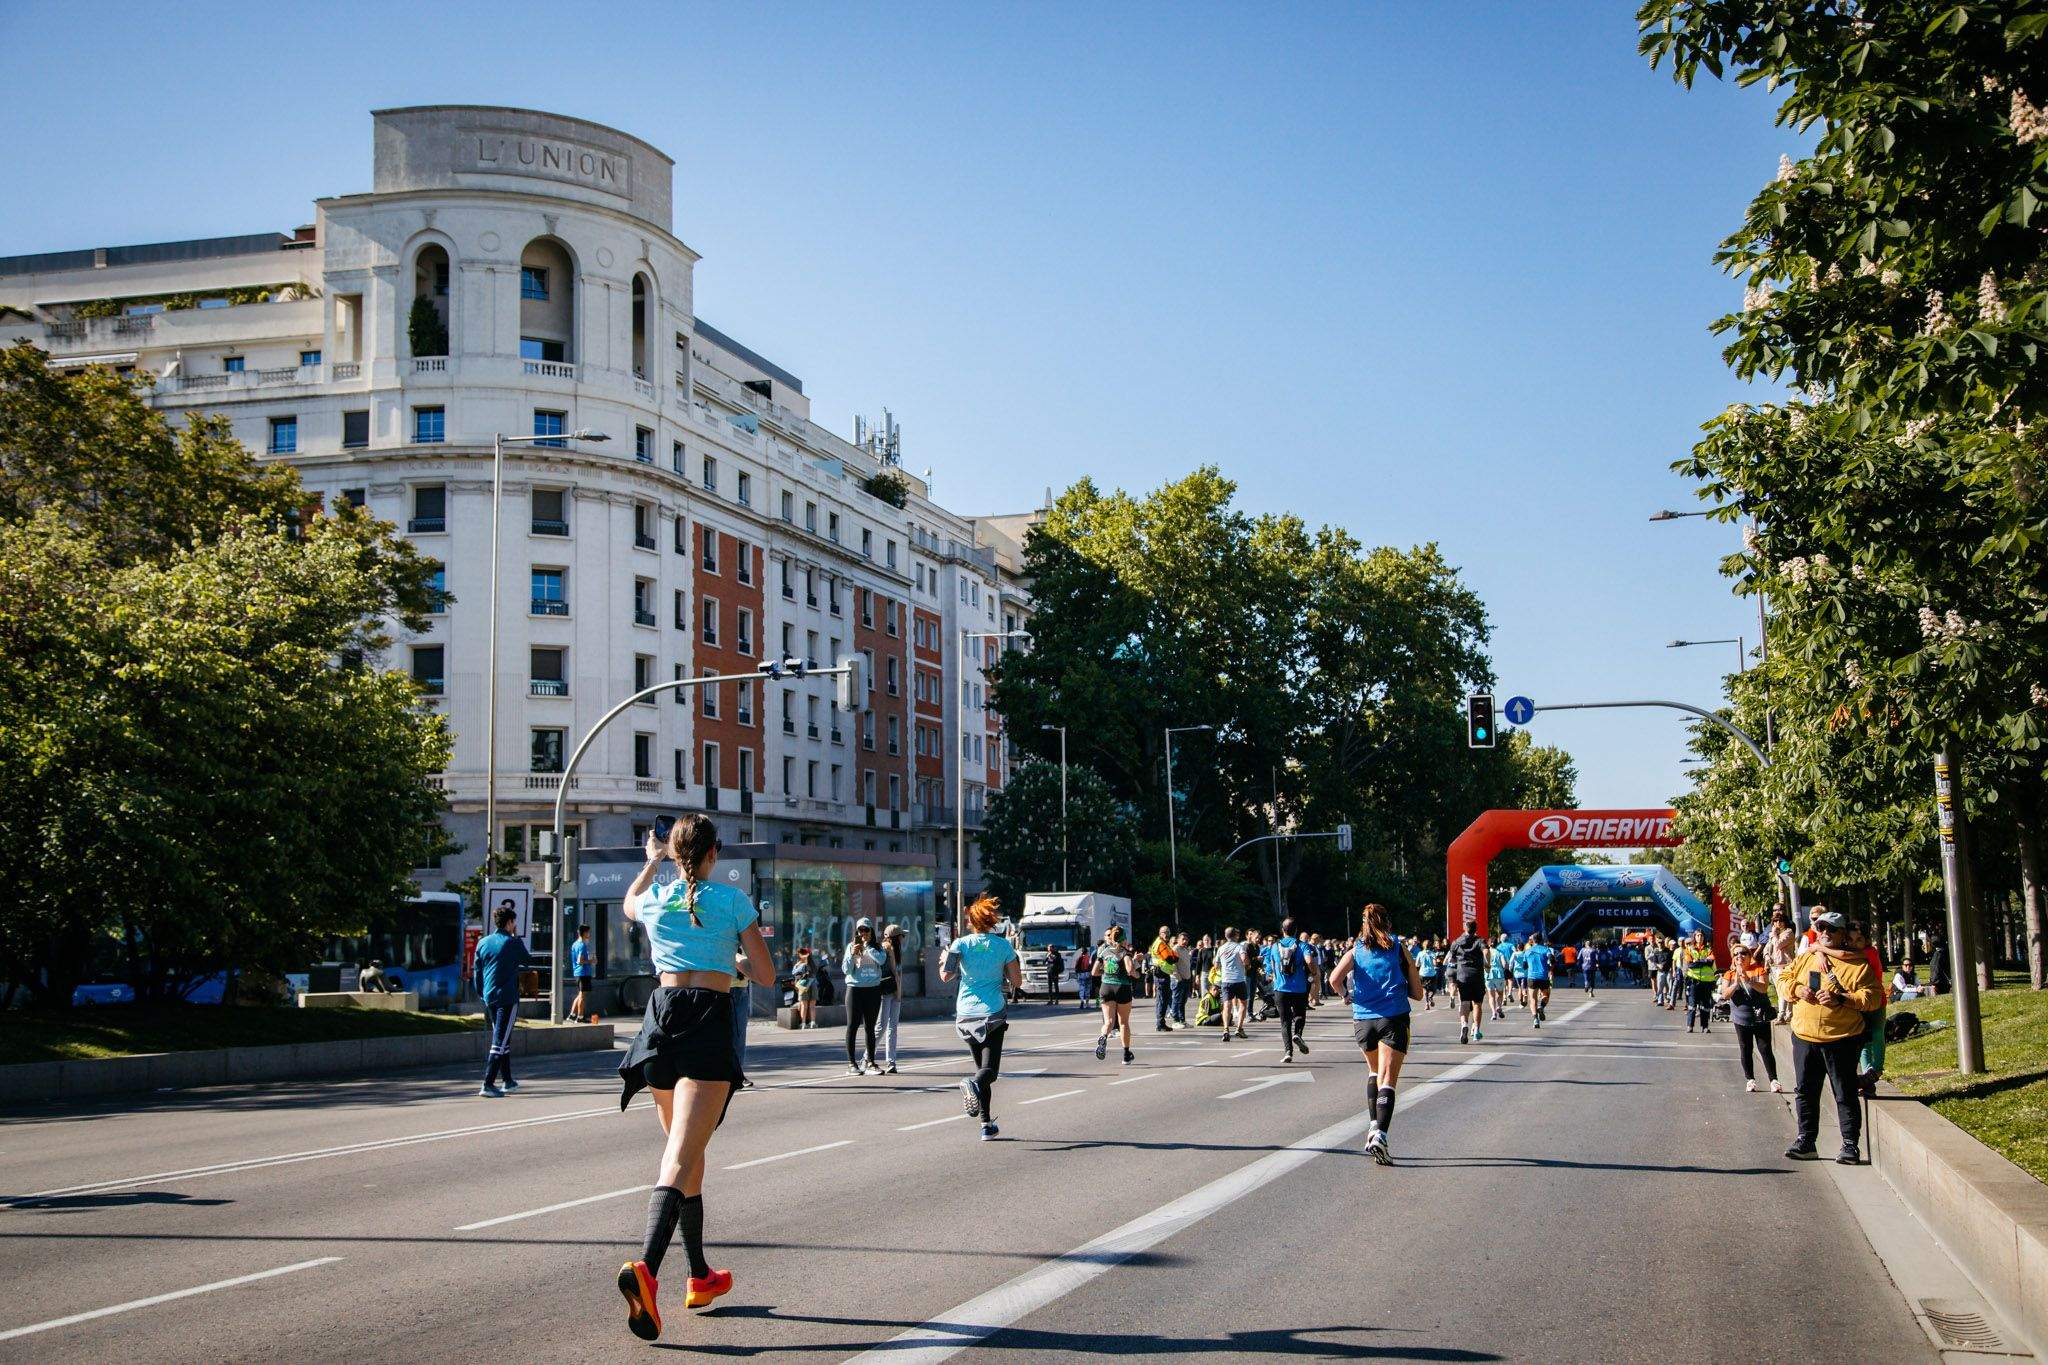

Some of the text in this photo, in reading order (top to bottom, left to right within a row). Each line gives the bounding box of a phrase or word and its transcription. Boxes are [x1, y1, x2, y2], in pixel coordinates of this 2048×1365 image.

[477, 138, 616, 183] L'UNION
[1569, 817, 1669, 841] ENERVIT
[1598, 908, 1649, 917] DECIMAS
[791, 915, 922, 955] RECOEOS
